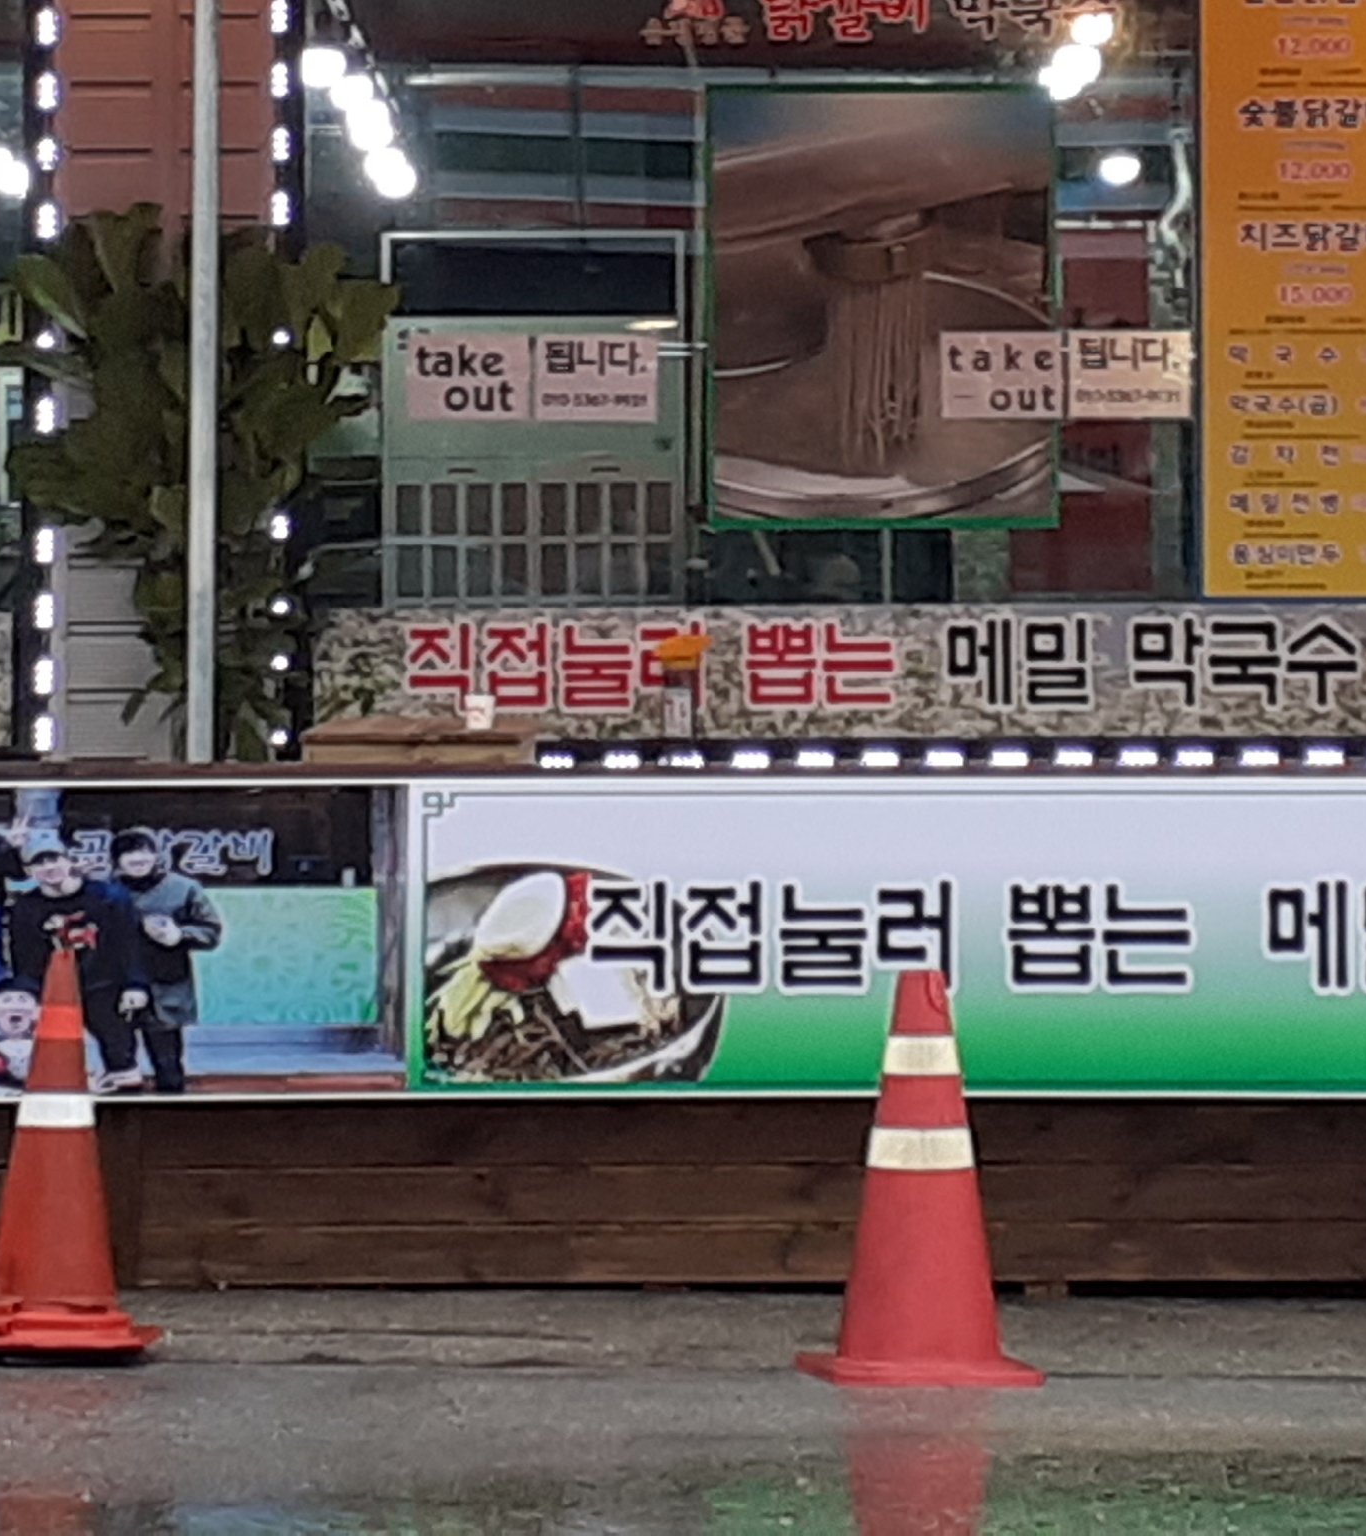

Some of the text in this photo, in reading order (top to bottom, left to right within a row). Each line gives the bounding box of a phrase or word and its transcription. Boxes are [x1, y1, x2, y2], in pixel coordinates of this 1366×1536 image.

[414, 342, 504, 378] take
[947, 342, 1054, 373] take
[443, 380, 515, 412] out
[745, 622, 895, 707] 뽑는
[945, 617, 1091, 708] 메밀
[1132, 617, 1360, 709] 막국수
[589, 879, 954, 992] 직접눌러
[1006, 879, 1192, 991] 뽑는
